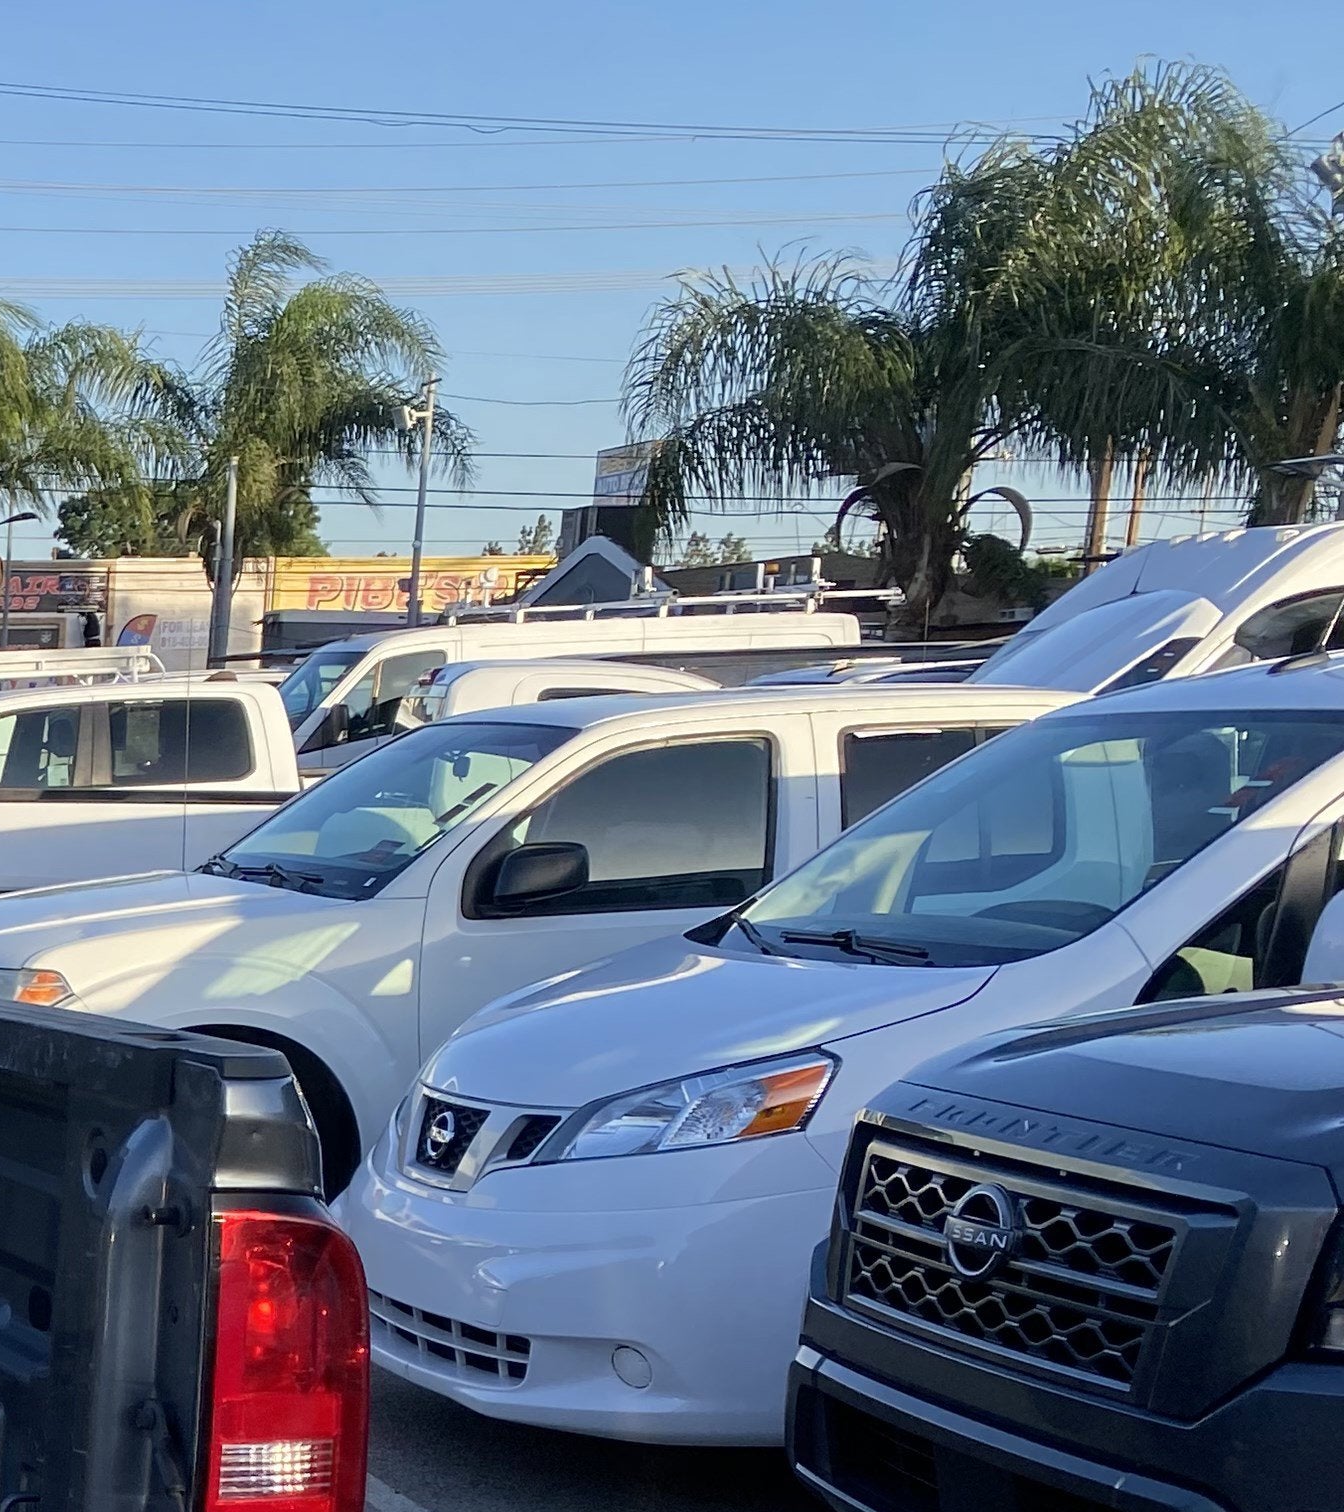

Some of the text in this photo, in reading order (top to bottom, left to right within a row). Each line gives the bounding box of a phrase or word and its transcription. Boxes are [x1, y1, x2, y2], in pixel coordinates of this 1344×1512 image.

[163, 621, 183, 634] FOR
[186, 621, 210, 634] LEA
[947, 1223, 1008, 1249] SSAN
